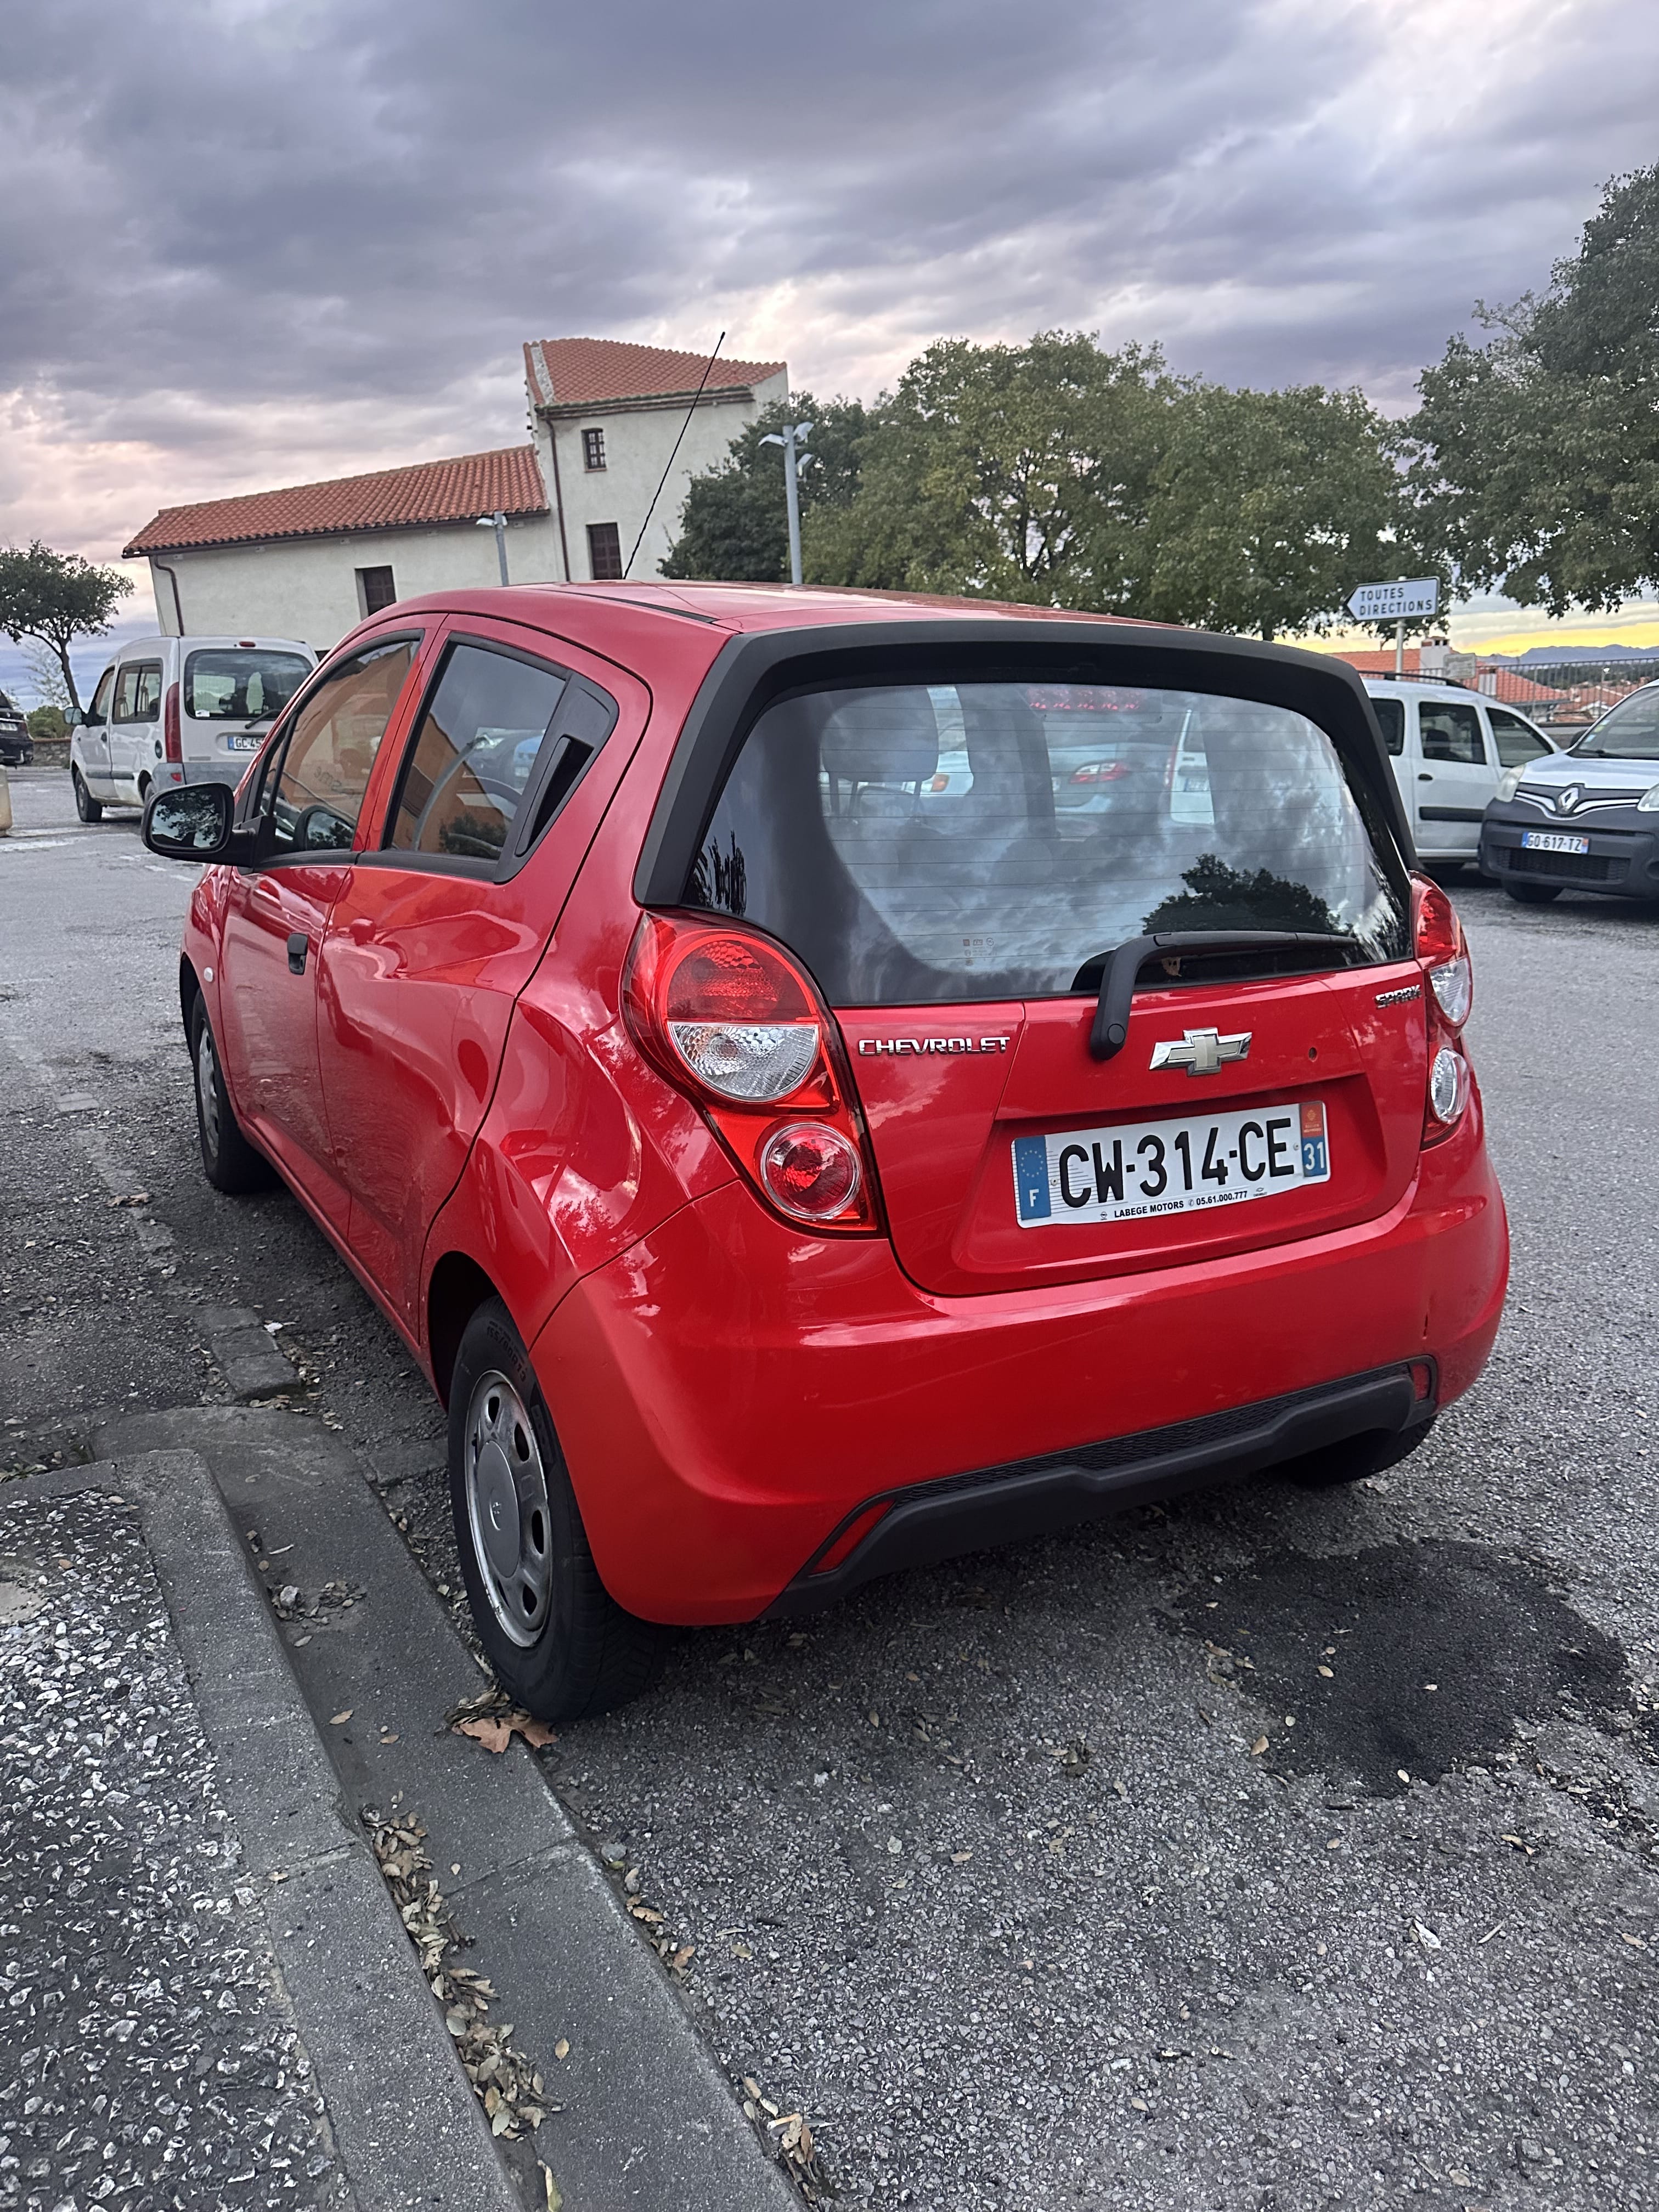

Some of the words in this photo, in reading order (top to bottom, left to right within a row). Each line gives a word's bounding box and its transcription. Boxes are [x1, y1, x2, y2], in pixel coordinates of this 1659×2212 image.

[1360, 587, 1404, 602] TOUTES
[1359, 599, 1433, 616] DIRECTIONS
[1375, 984, 1422, 1009] SPARK
[859, 1036, 1011, 1056] CHEVROLET
[1059, 1118, 1295, 1209] CW-314-CE
[1304, 1141, 1325, 1170] 31
[1029, 1188, 1040, 1207] F
[1114, 1206, 1148, 1218] LABEGE
[1150, 1200, 1184, 1213] MOTORS
[1196, 1190, 1248, 1205] 05.61.000.777
